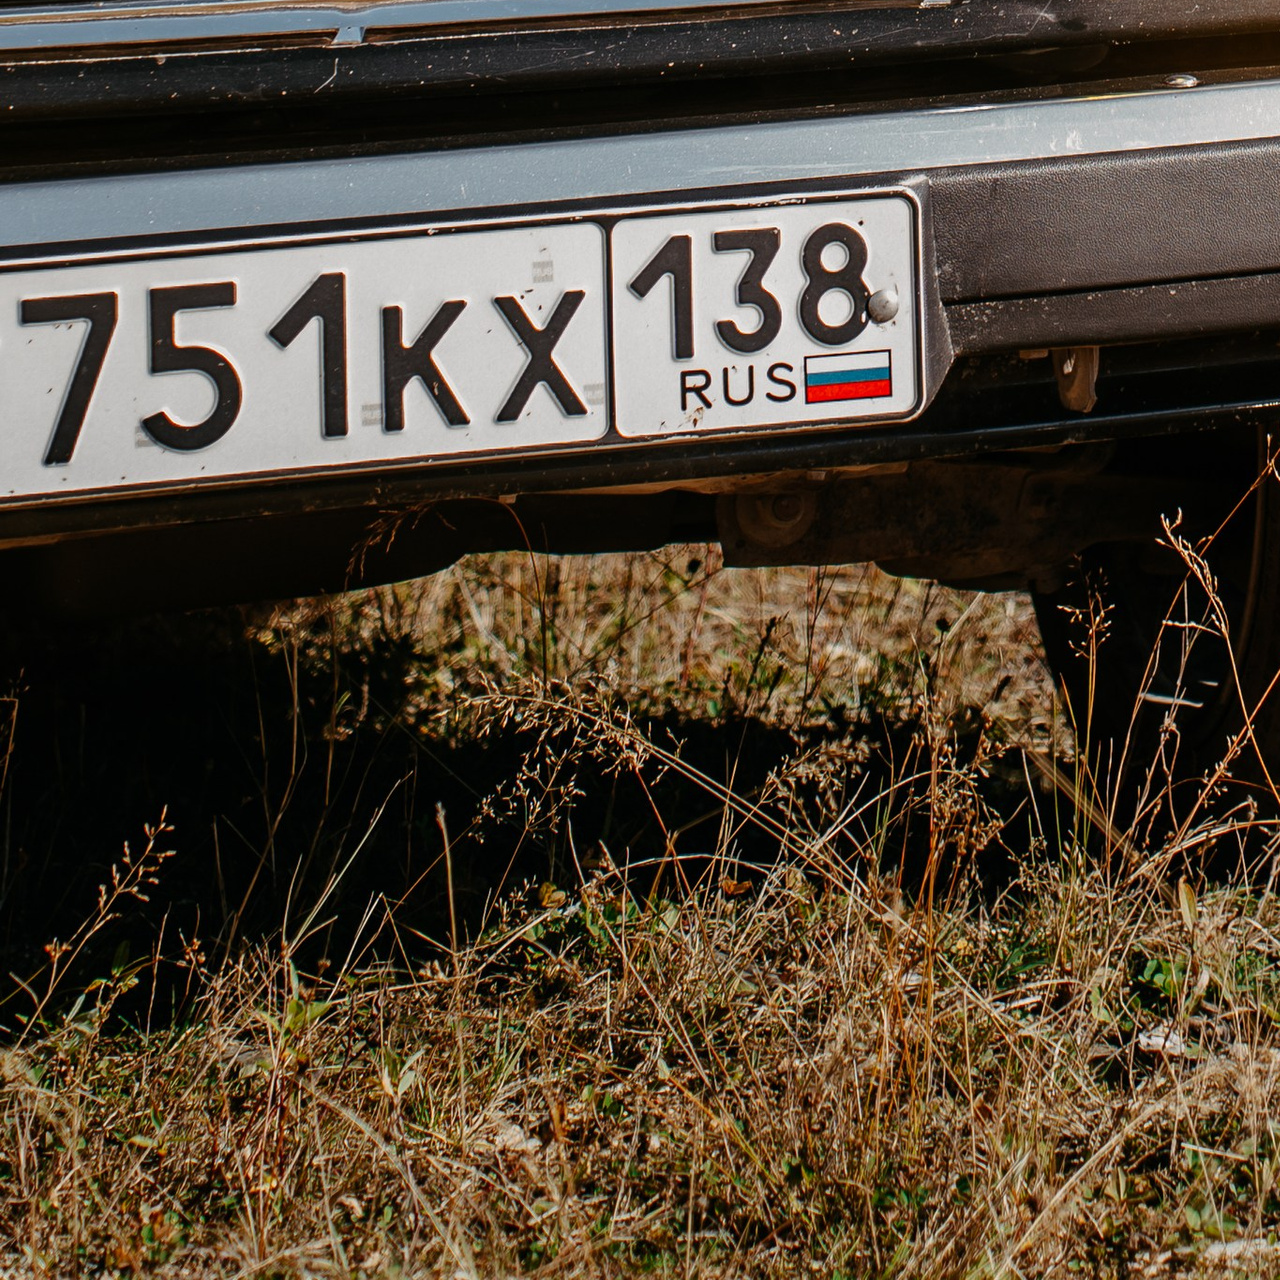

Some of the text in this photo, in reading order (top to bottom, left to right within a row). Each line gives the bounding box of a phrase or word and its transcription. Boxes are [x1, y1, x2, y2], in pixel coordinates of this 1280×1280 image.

[20, 222, 870, 467] 751KX 138
[680, 361, 797, 412] RUS
